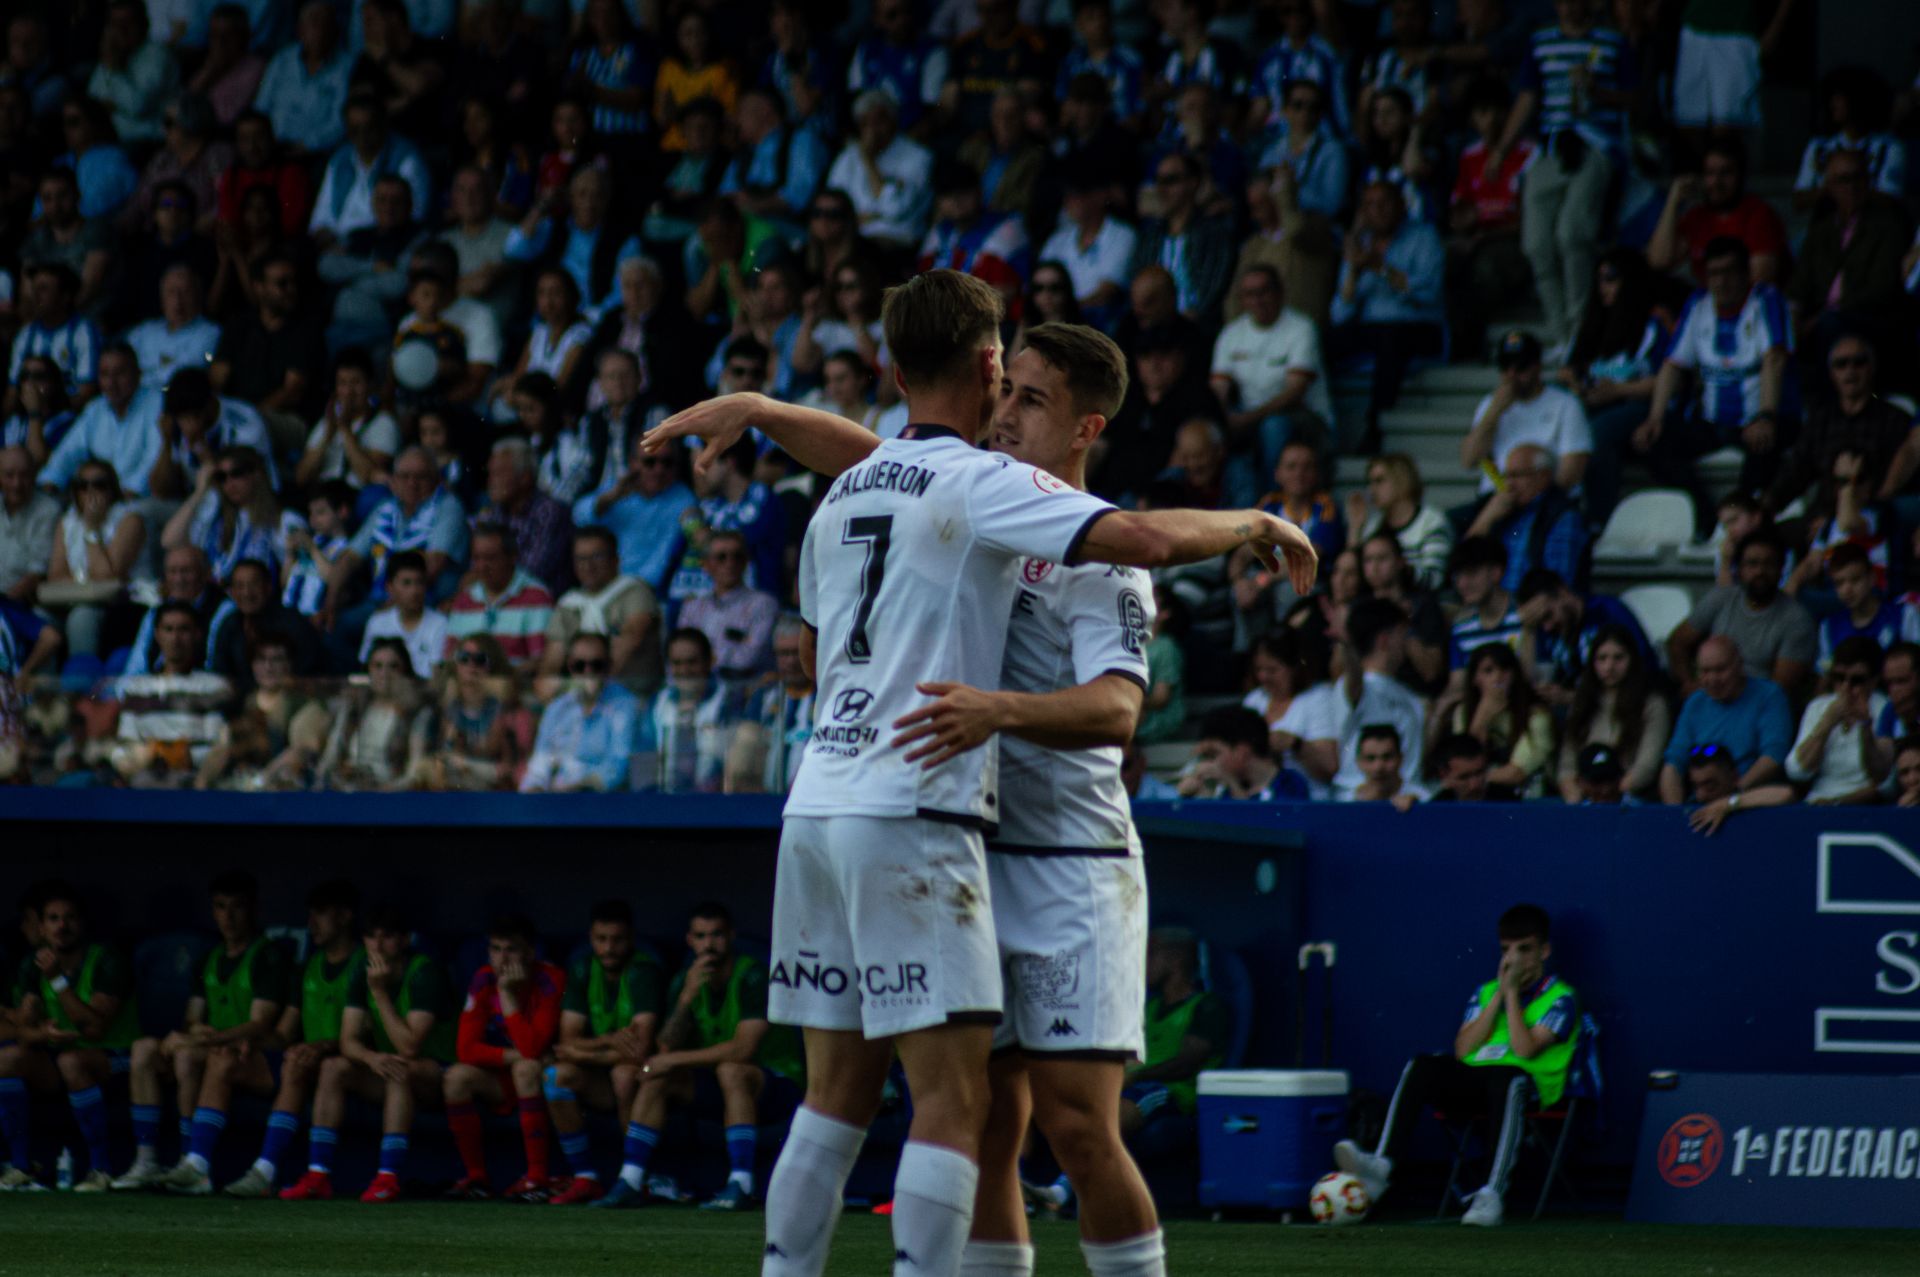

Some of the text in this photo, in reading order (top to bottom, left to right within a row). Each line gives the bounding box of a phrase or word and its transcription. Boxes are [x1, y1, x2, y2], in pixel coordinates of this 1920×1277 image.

[828, 459, 936, 505] CALDERÓN
[841, 514, 893, 664] 7
[866, 963, 927, 995] CJR
[1769, 1125, 1920, 1180] FEDERAC
